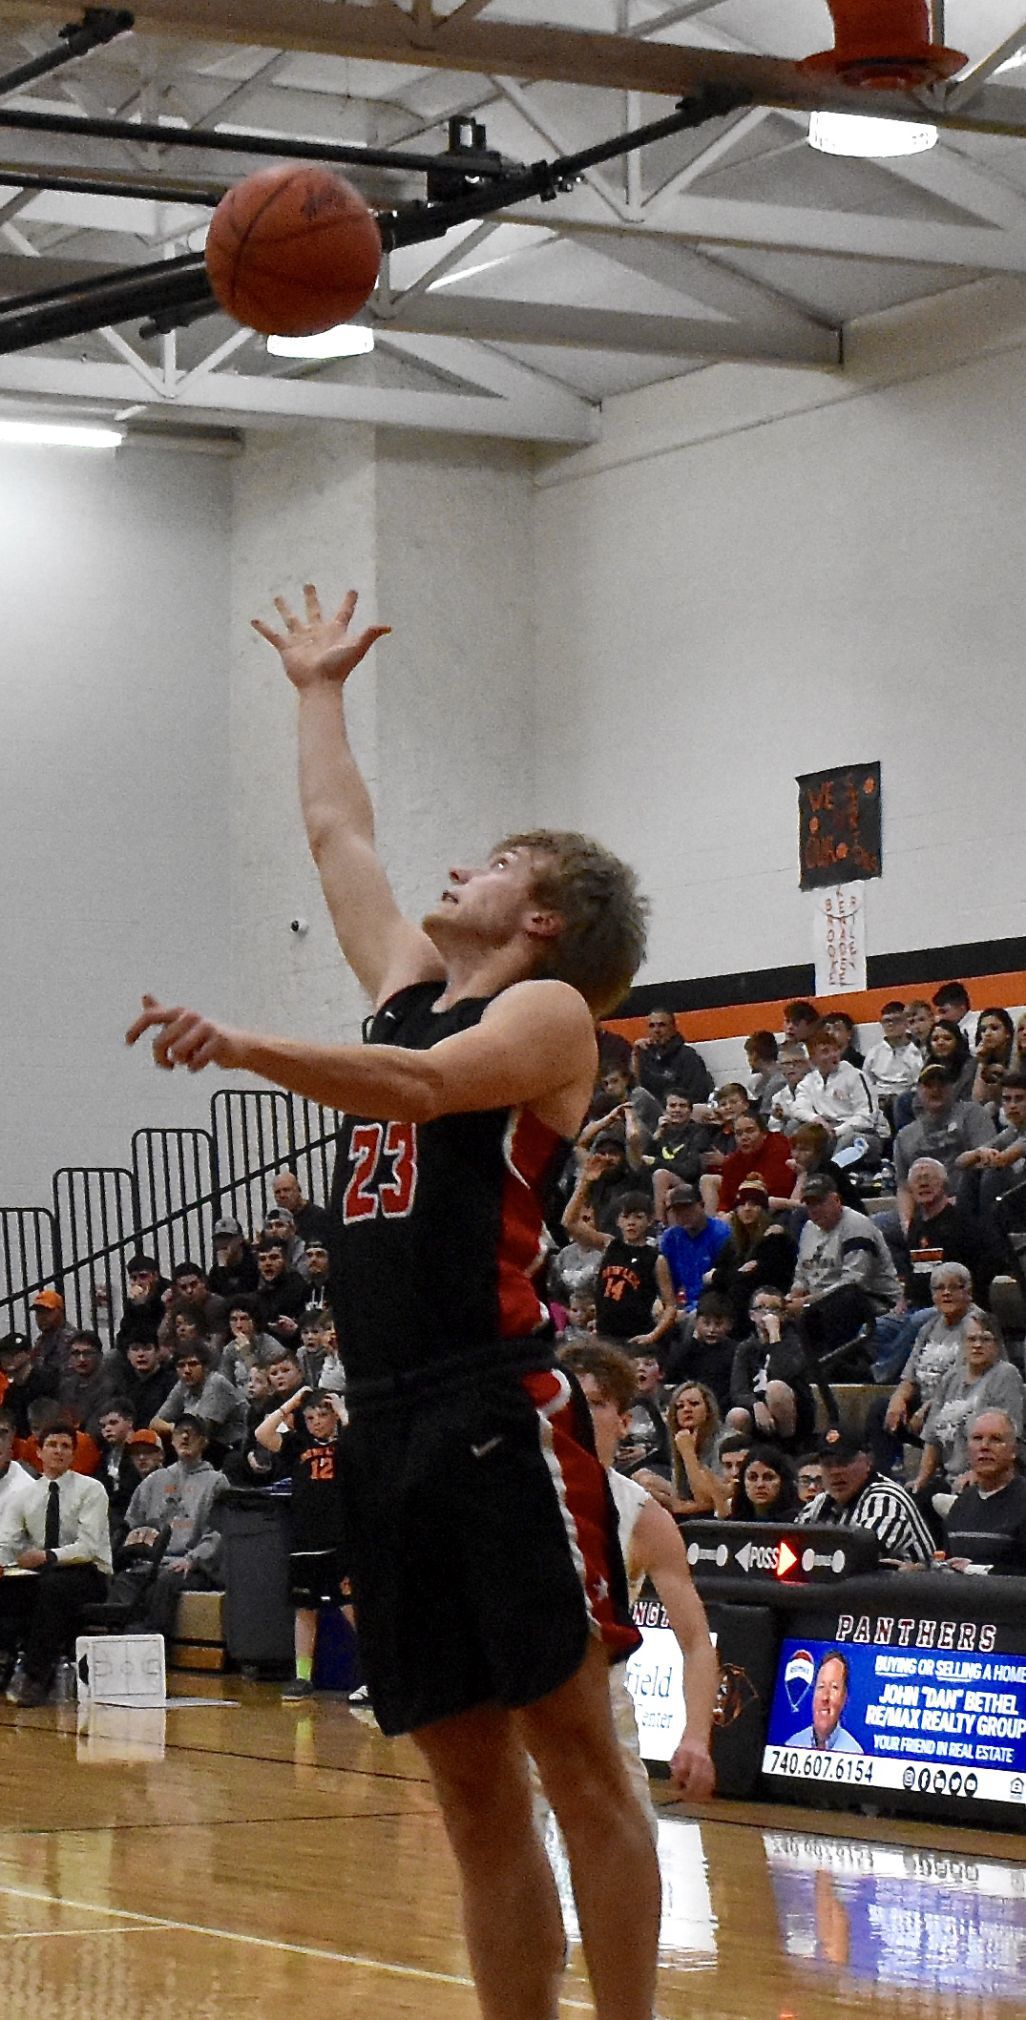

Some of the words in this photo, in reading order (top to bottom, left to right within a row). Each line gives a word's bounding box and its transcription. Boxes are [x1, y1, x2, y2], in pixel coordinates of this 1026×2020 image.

[342, 1120, 418, 1226] 23
[602, 1278, 626, 1302] 14
[310, 1457, 334, 1480] 12
[750, 1546, 779, 1569] POSS
[836, 1614, 997, 1652] PANTHERS
[875, 1655, 917, 1676] BUYING
[917, 1659, 935, 1676] OR
[936, 1660, 983, 1680] SELLING
[983, 1664, 992, 1680] A
[993, 1665, 1026, 1683] HOME
[879, 1684, 920, 1706] JOHN
[921, 1686, 964, 1710] "DAN"
[964, 1691, 1019, 1715] BETHEL
[865, 1704, 921, 1729] RE/MAX
[921, 1709, 976, 1734] REALTY
[976, 1715, 1026, 1739] GROUP
[874, 1734, 900, 1751] YOUR
[901, 1737, 936, 1755] FRIEND
[936, 1741, 948, 1756] IN
[949, 1742, 974, 1759] REAL
[975, 1744, 1015, 1763] ESTATE
[770, 1751, 873, 1783] 740.607.6154
